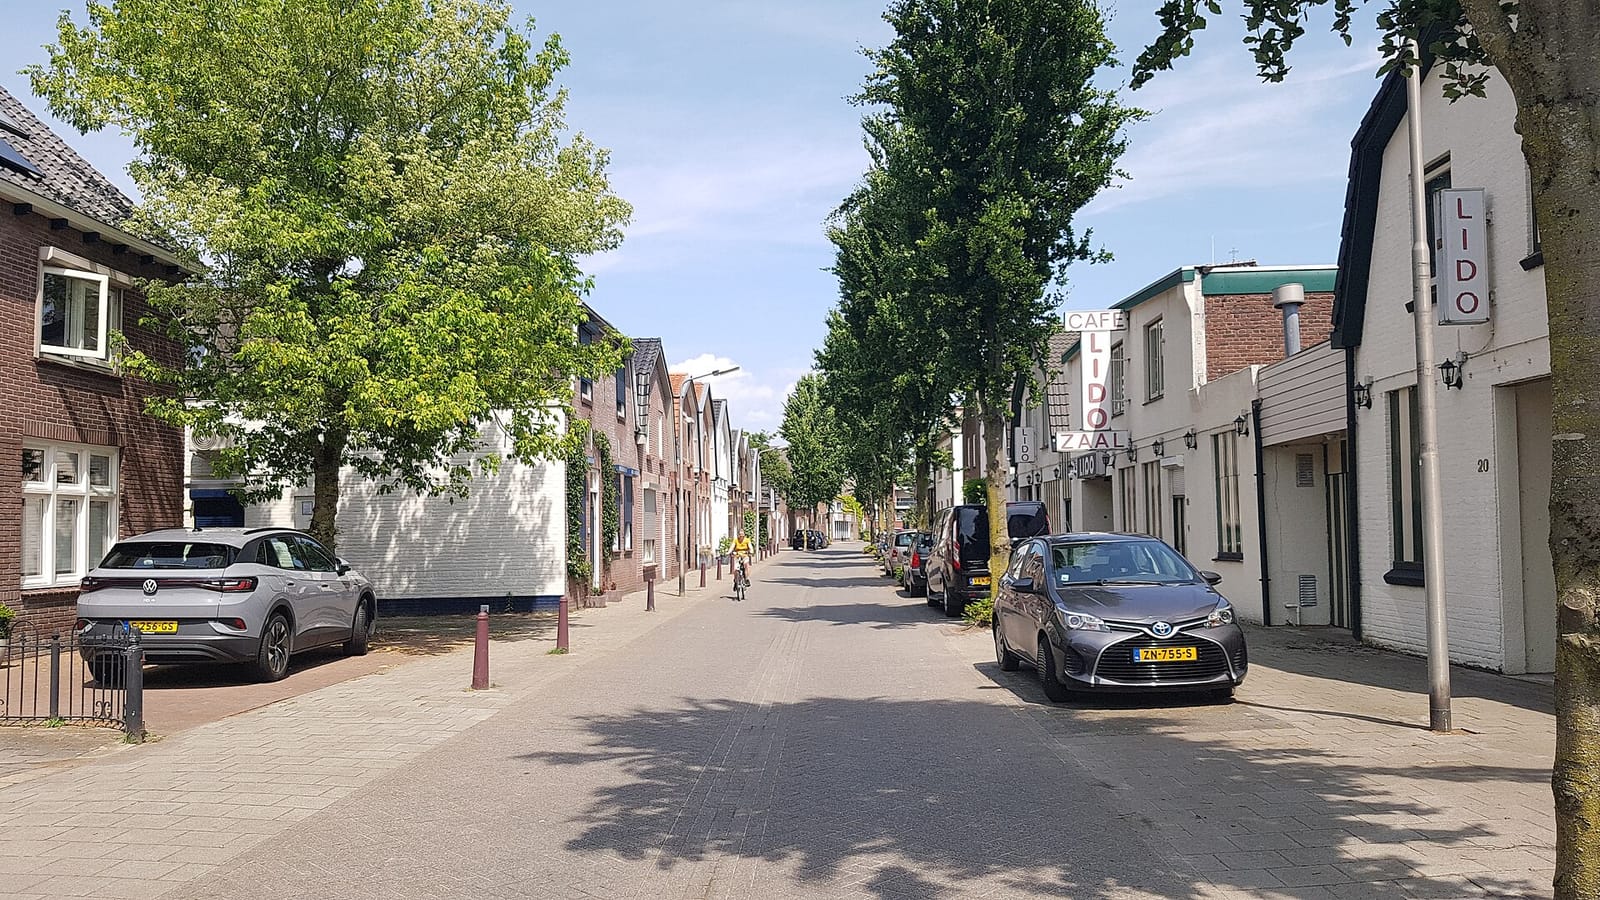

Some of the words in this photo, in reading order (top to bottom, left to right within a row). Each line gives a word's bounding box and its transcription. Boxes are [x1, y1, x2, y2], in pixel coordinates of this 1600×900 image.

[1456, 198, 1479, 314] LIDO
[1068, 312, 1124, 328] CAFE
[1087, 333, 1108, 429] LIDO
[1021, 428, 1029, 461] LIDO
[1060, 432, 1125, 449] ZAAL
[1079, 455, 1095, 477] LIDO
[1477, 458, 1489, 473] 20
[1143, 648, 1192, 660] ZN-755-S
